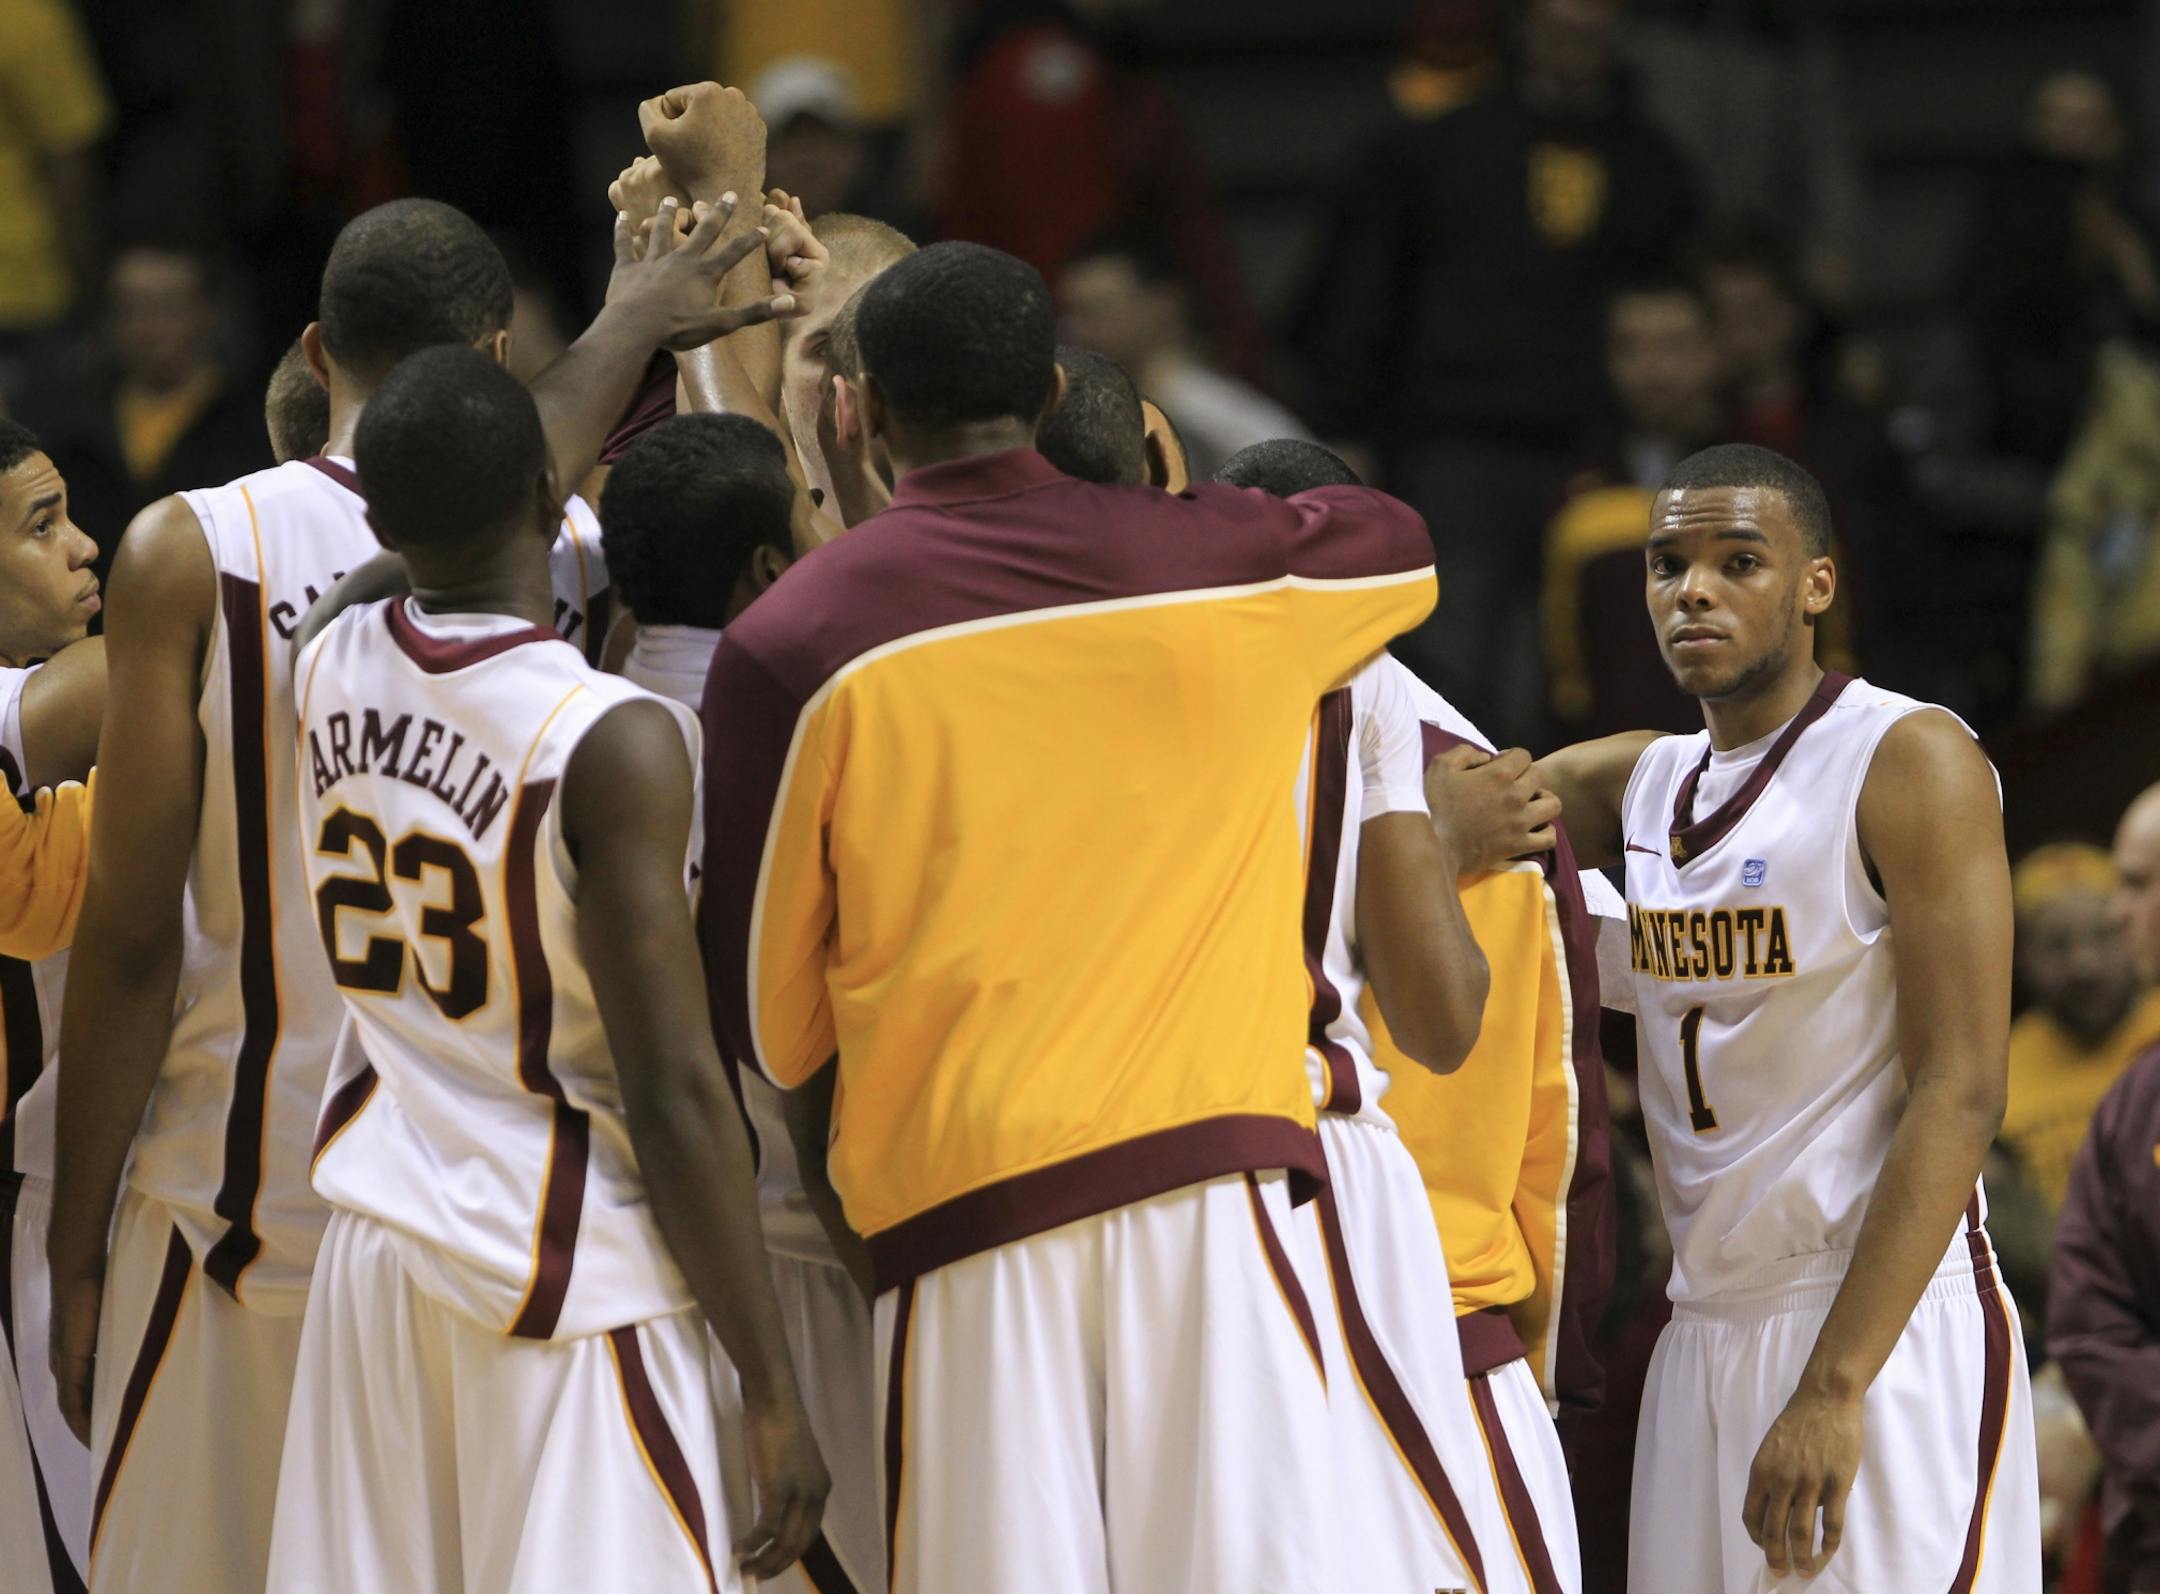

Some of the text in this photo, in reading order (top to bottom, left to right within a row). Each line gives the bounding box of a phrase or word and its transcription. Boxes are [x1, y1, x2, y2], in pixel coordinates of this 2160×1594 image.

[309, 708, 509, 841] ARMELIN
[314, 804, 490, 1022] 23
[1627, 903, 1796, 980] MNESOTA
[1679, 1003, 1720, 1134] 1
